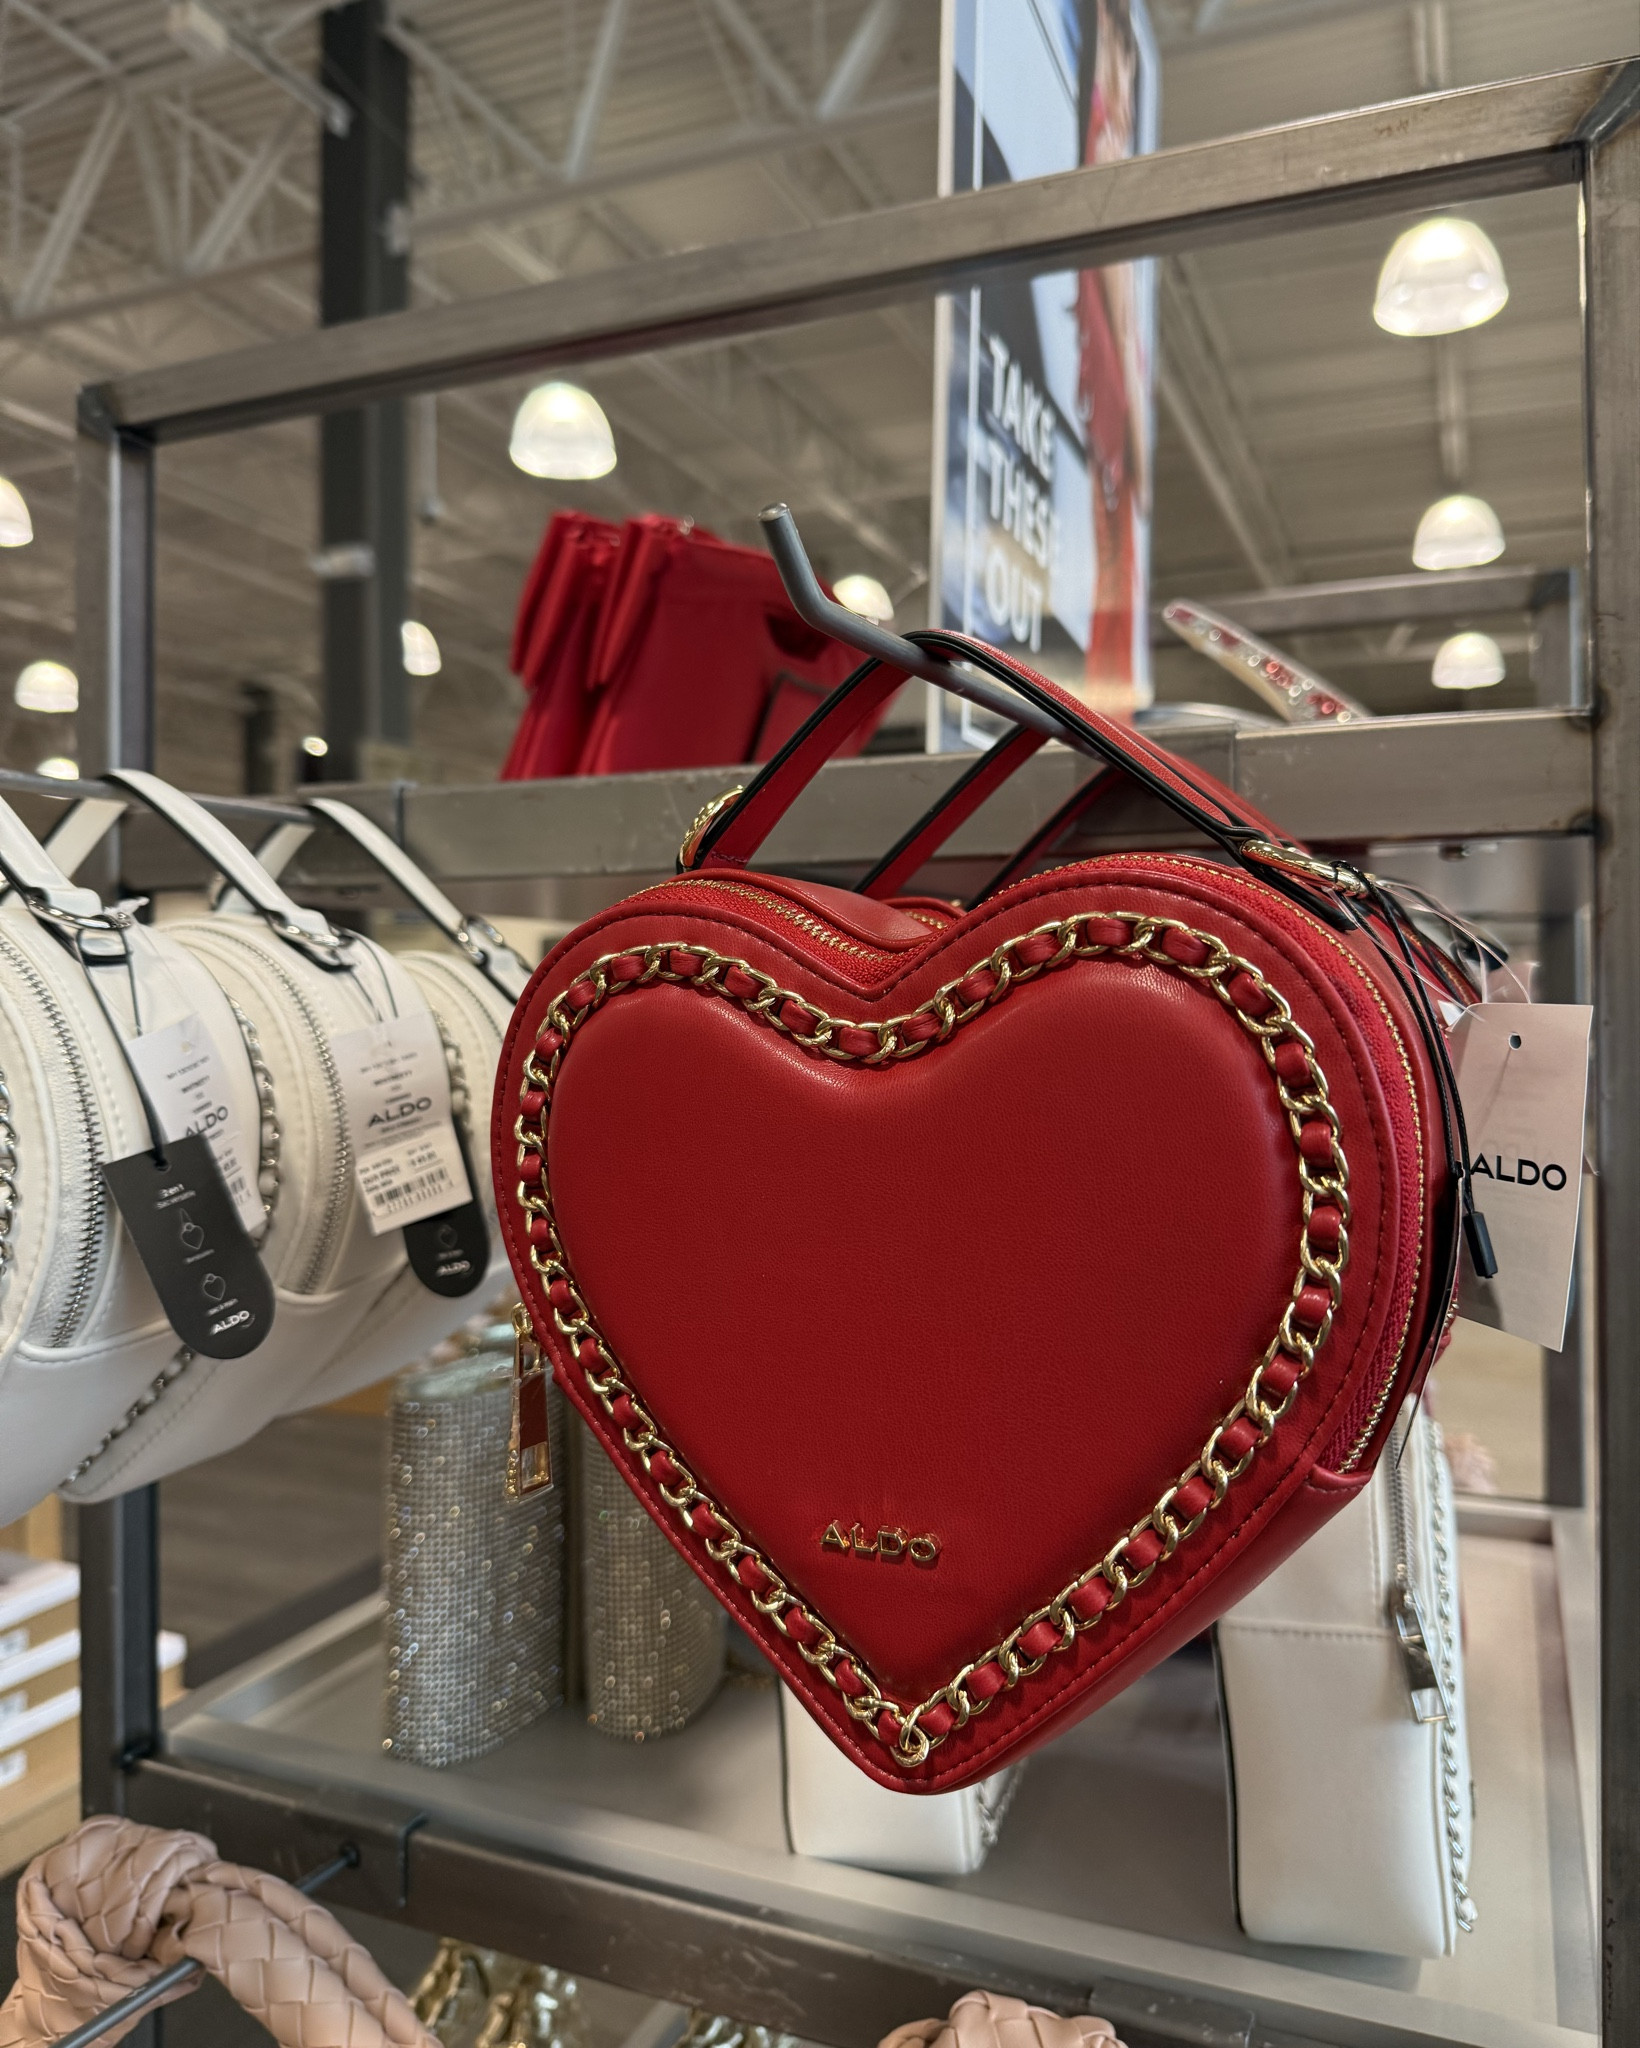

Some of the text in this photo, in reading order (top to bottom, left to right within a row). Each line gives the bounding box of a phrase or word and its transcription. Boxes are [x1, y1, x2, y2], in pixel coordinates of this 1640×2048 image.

[989, 334, 1056, 484] TAKE
[985, 546, 1044, 653] OUT
[184, 1105, 229, 1138] ALDO
[367, 1096, 433, 1128] ALDO
[1470, 1152, 1567, 1192] ALDO
[210, 1310, 250, 1336] ALDO
[820, 1519, 941, 1562] ALDO
